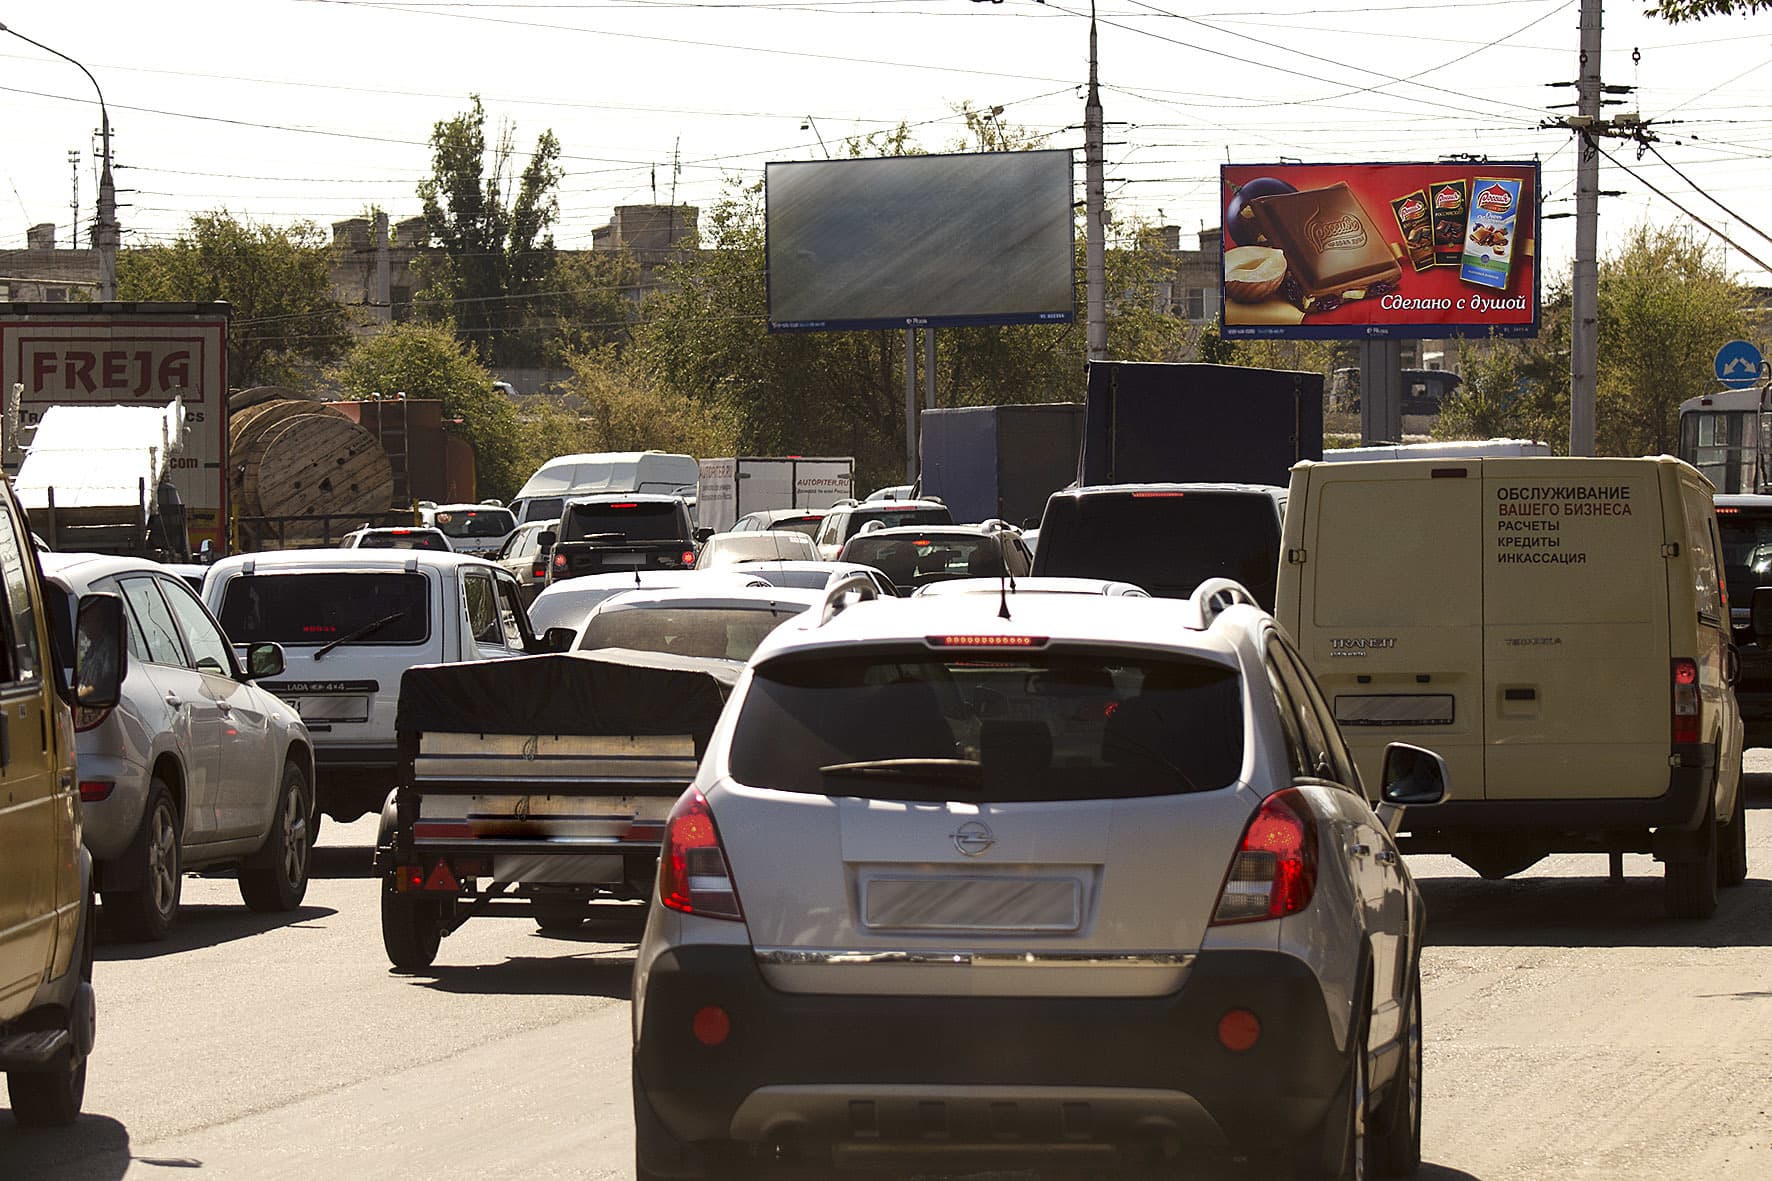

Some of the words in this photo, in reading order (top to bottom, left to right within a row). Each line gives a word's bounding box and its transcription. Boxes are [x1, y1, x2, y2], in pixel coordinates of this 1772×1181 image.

[1381, 294, 1451, 310] Сделано
[1456, 299, 1466, 310] с
[1470, 294, 1526, 312] душой
[33, 351, 191, 397] FREJA
[797, 479, 849, 487] AUTOPITER.RU
[1497, 486, 1630, 500] ОБСЛУЖИВАНИЕ
[1499, 503, 1560, 516] ВАШЕГО
[1564, 503, 1632, 516] БИЗНЕСА
[1498, 520, 1560, 531] РАСЧЕТЫ
[1498, 537, 1560, 549] КРЕДИТЫ
[1498, 553, 1586, 565] ИНКАССАЦИЯ
[1329, 638, 1398, 649] TRANSIT
